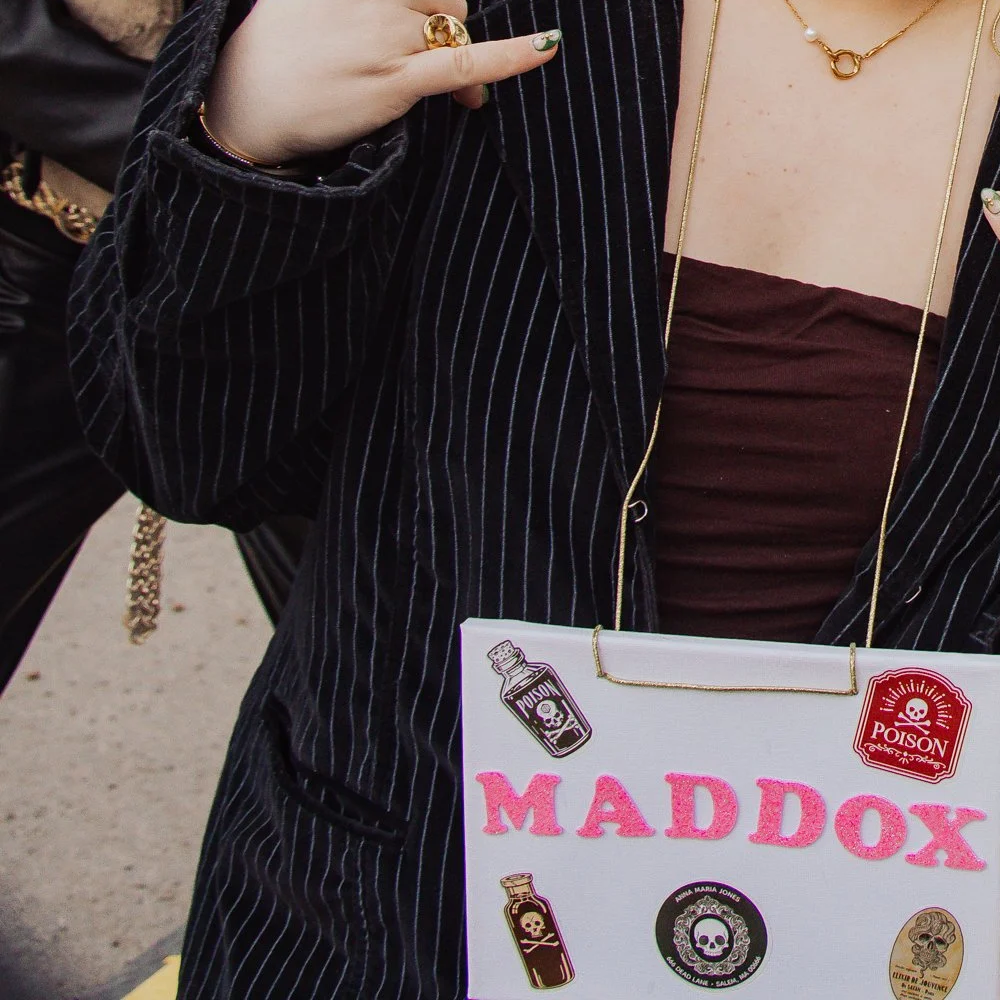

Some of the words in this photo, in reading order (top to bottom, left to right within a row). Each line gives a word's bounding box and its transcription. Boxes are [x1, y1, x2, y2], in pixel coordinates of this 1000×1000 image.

[515, 679, 562, 719] POISON
[871, 721, 949, 758] POISON
[475, 770, 989, 872] MADDOX
[675, 889, 693, 903] ANNA
[719, 888, 741, 903] JONES
[675, 966, 692, 980] DEAD
[692, 975, 709, 987] LANE
